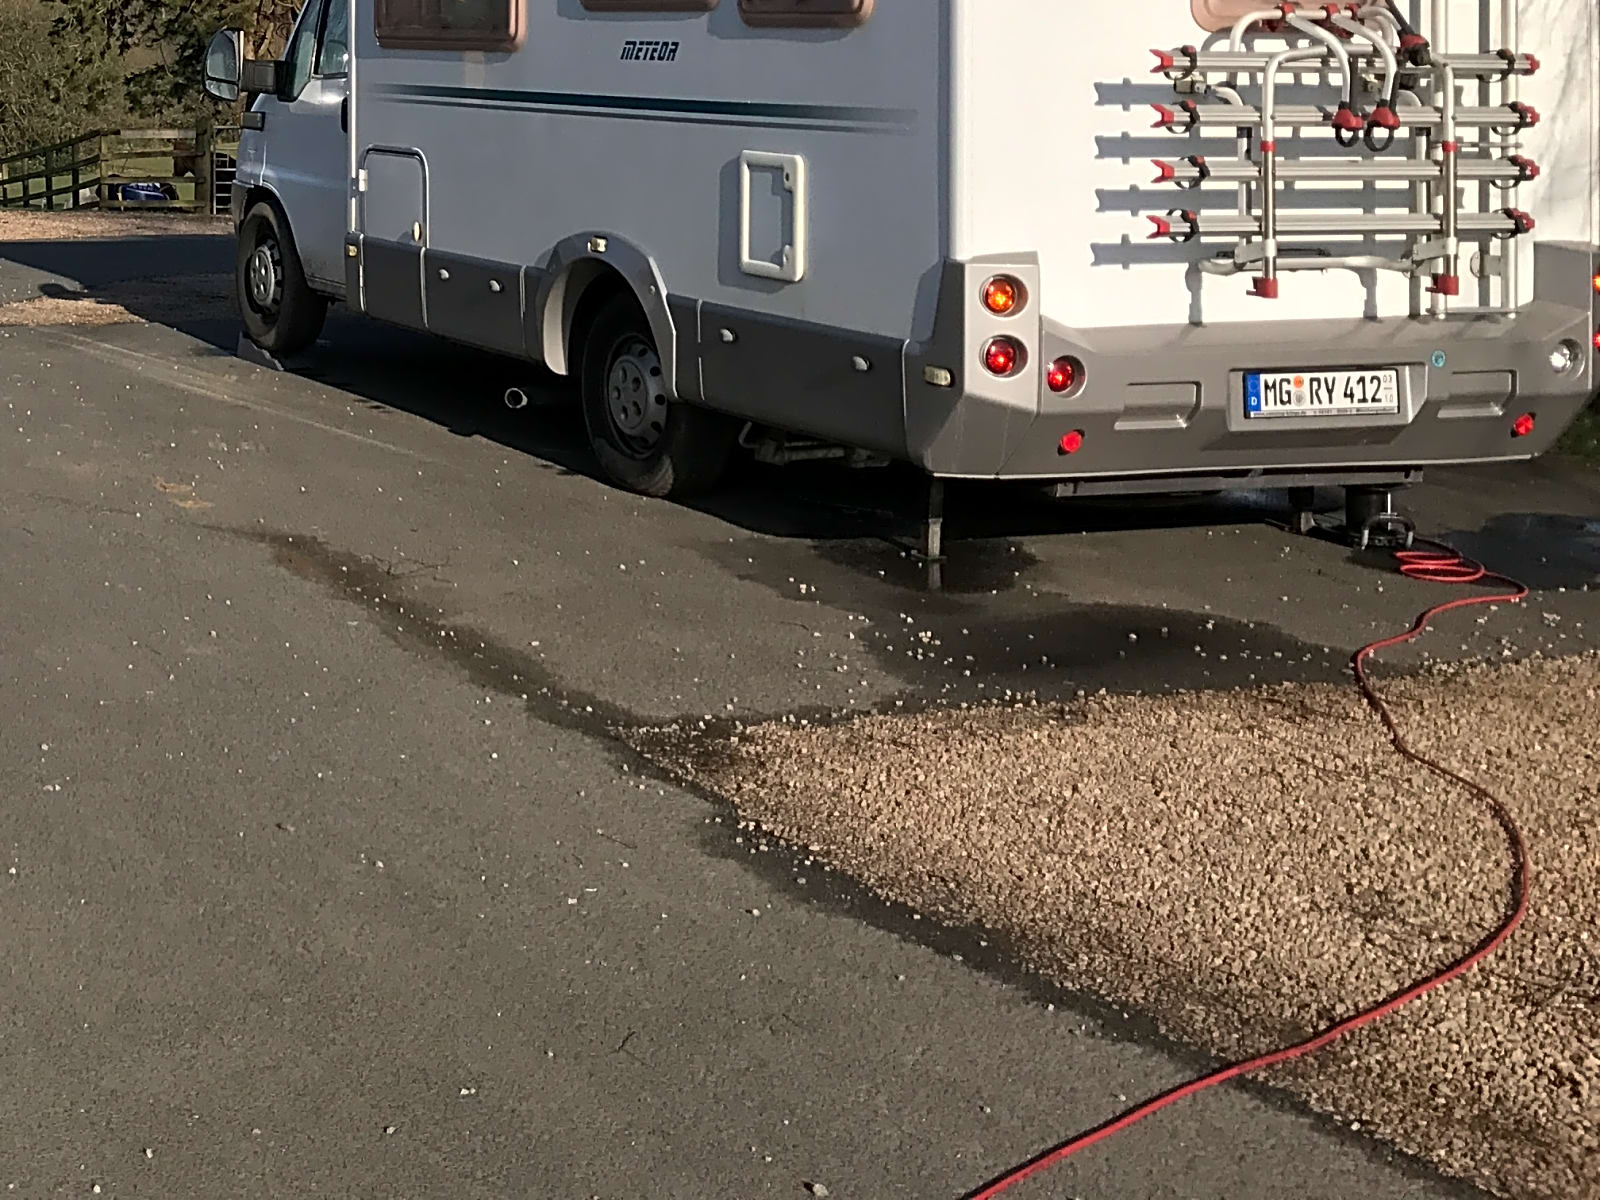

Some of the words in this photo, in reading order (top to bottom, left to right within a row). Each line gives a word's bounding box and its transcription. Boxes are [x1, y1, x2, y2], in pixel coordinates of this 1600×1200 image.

[620, 40, 679, 61] METEOR
[1251, 396, 1257, 406] D
[1264, 377, 1292, 407] MG
[1309, 376, 1336, 406] RY
[1343, 375, 1382, 404] 412
